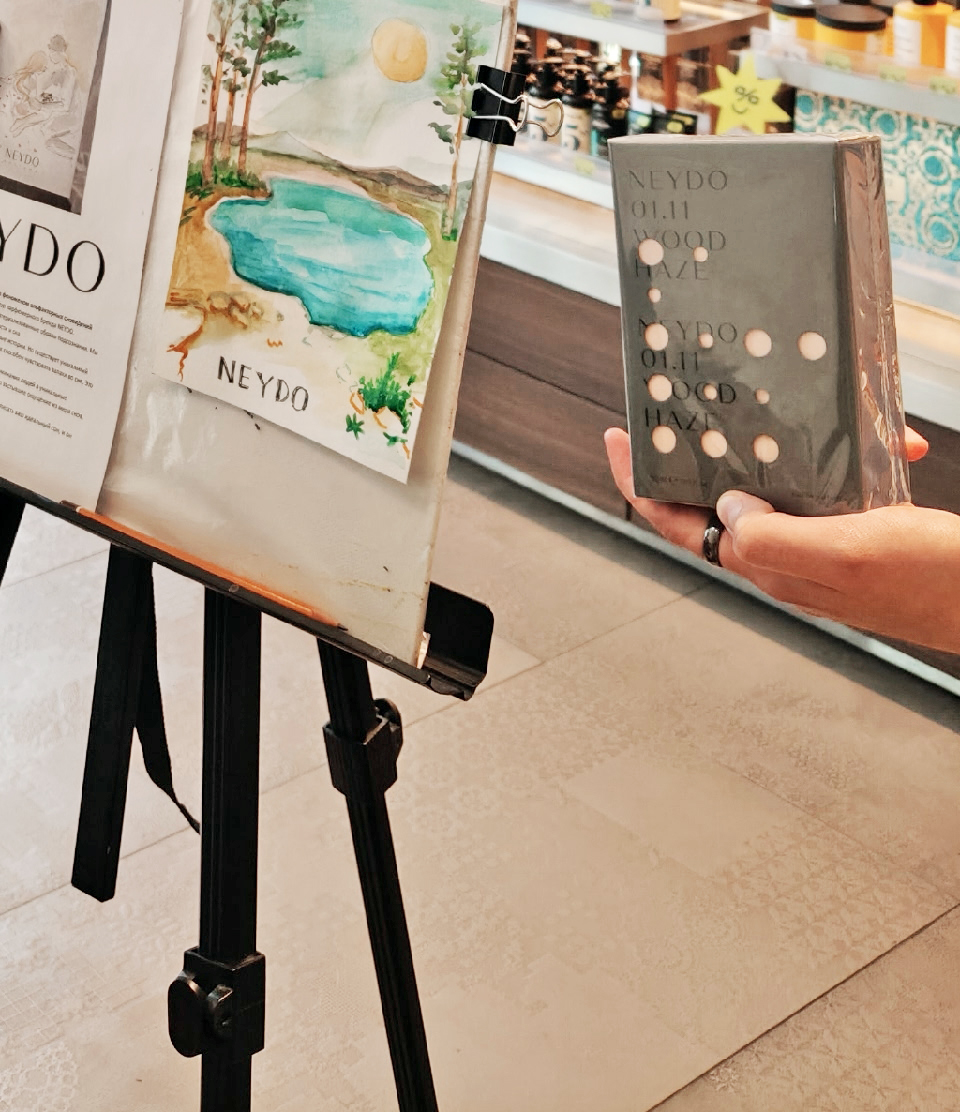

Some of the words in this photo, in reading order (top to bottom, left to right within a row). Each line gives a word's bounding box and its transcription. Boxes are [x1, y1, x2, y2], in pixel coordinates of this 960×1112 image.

[6, 147, 40, 168] NEYDO
[628, 169, 728, 191] NEYDO
[631, 200, 689, 220] 01.11
[635, 258, 710, 281] HAZE
[641, 348, 699, 371] 01.11
[217, 355, 309, 412] NEYDO
[643, 378, 736, 405] OOD
